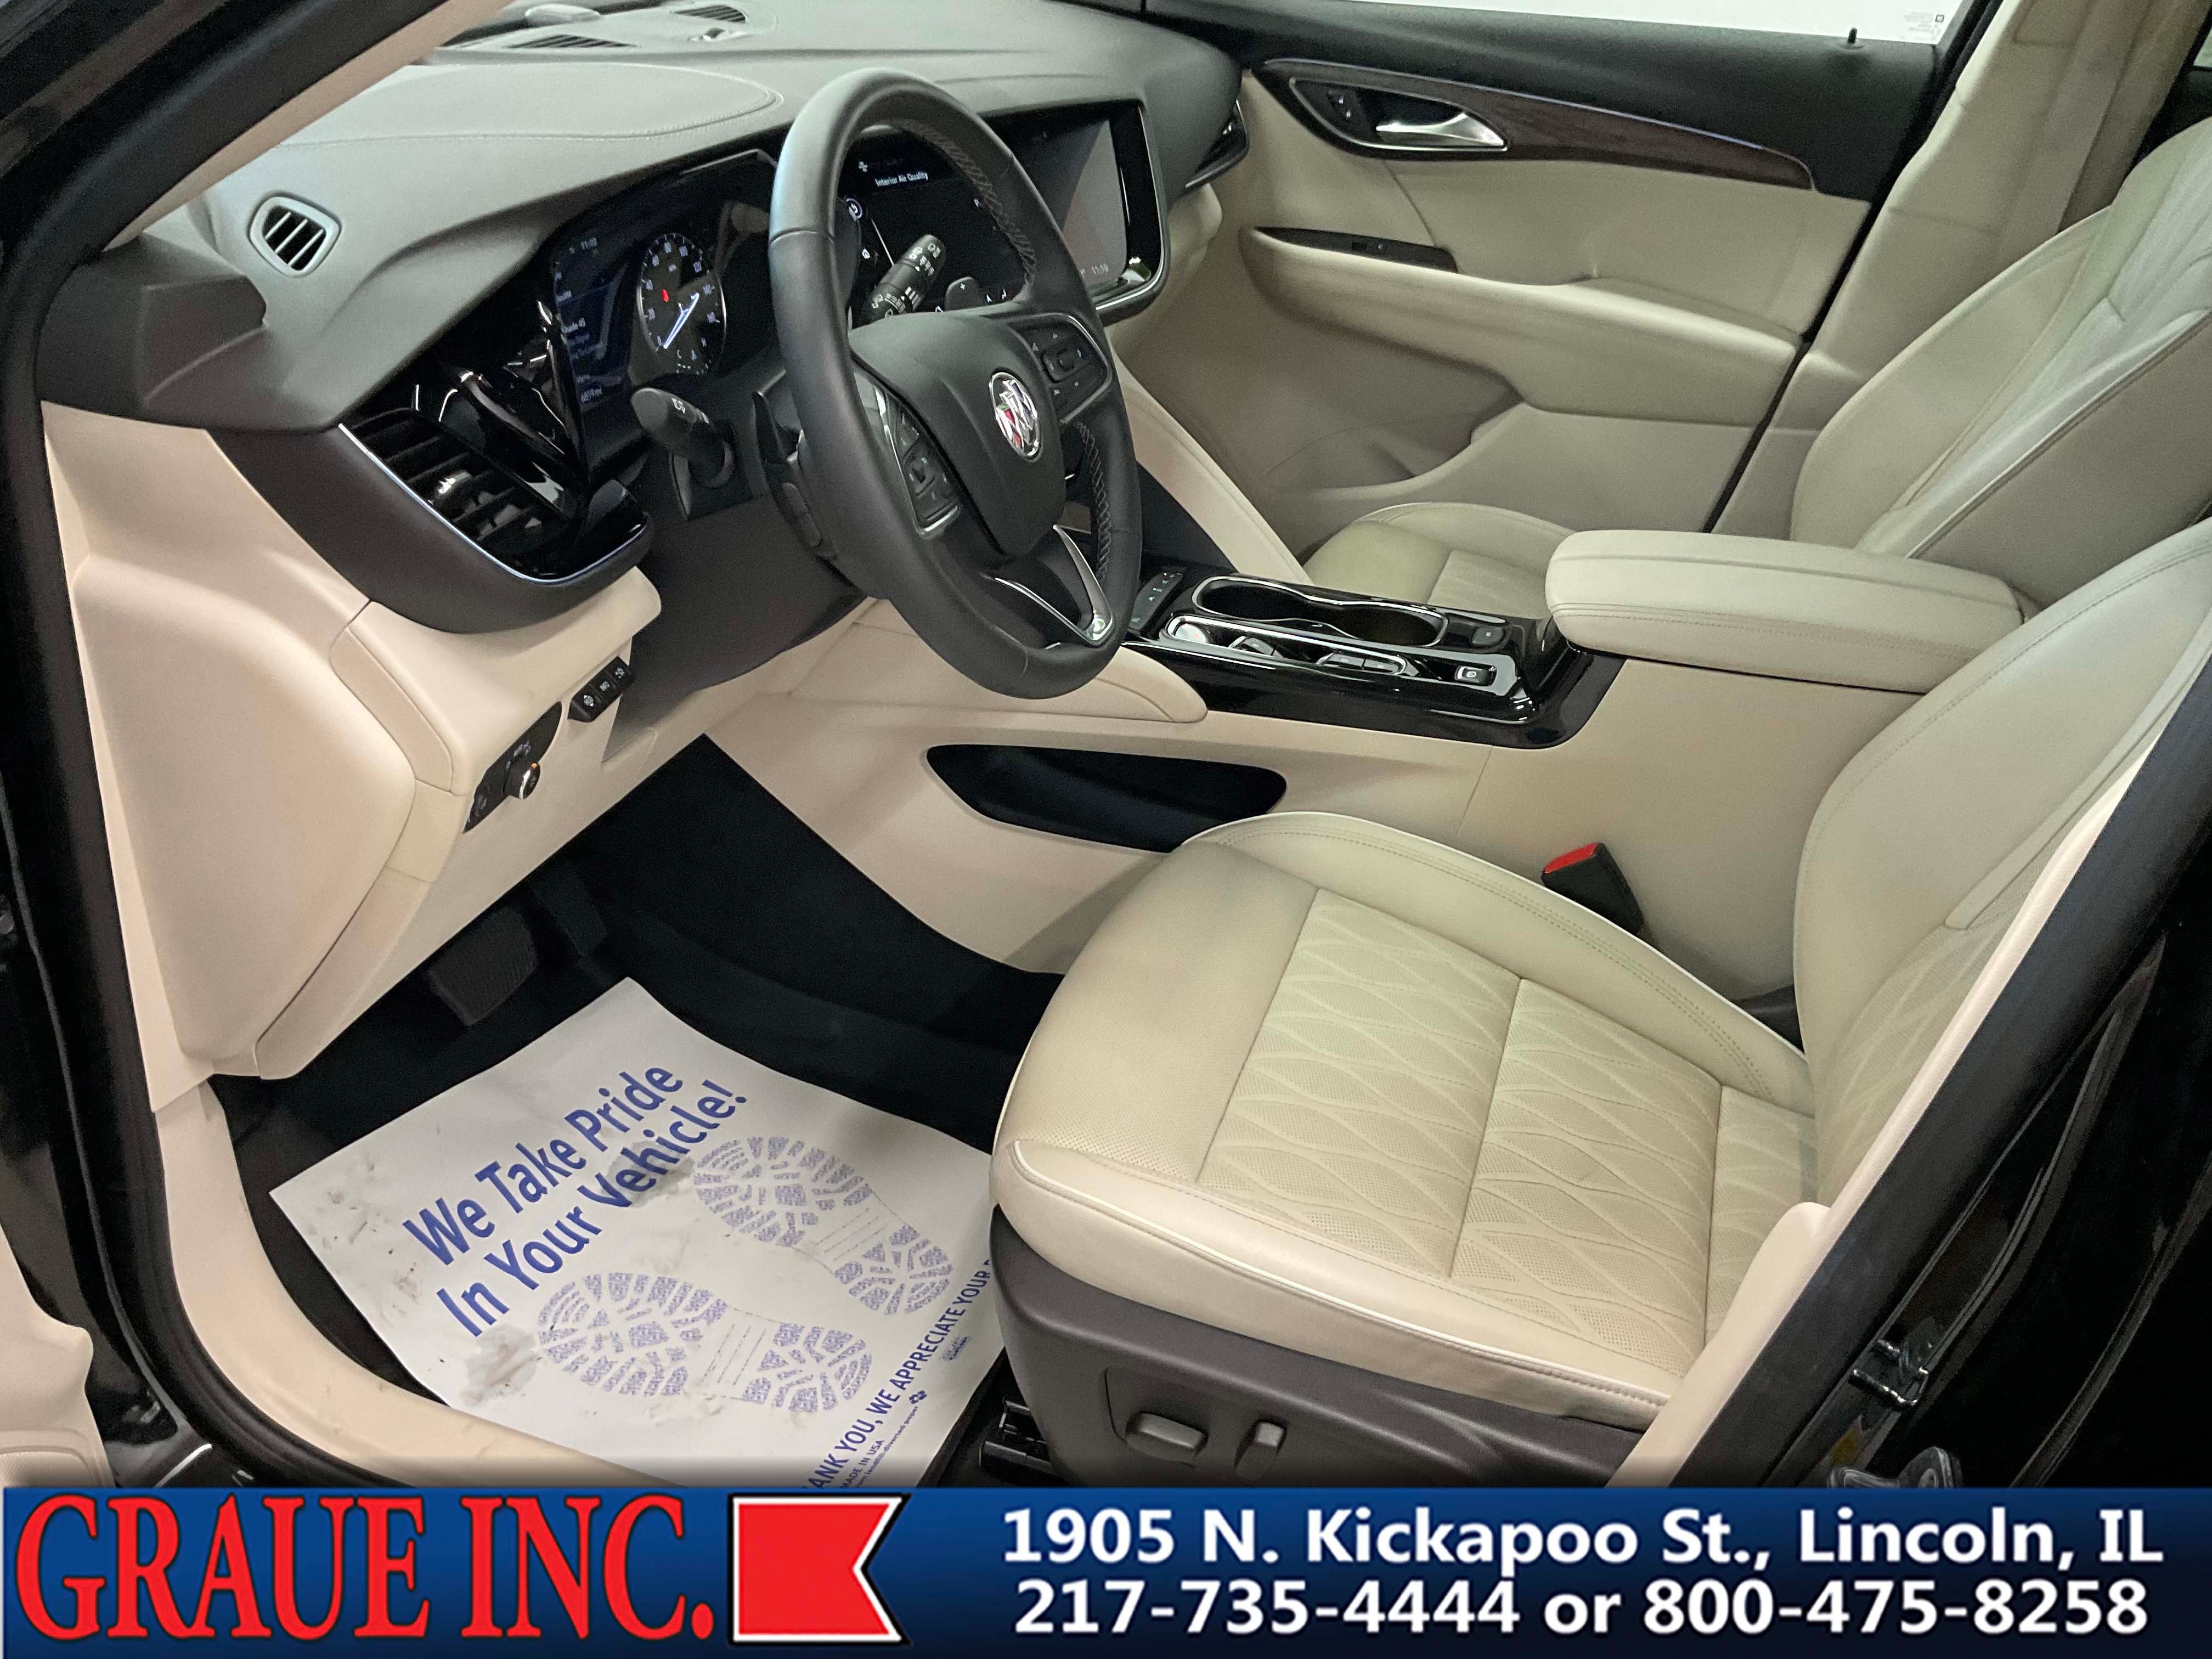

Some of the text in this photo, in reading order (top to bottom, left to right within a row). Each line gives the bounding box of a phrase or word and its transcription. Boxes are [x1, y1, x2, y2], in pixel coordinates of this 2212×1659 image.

[874, 171, 928, 187] Interior Air Quality
[402, 1066, 684, 1266] We Take Pride
[436, 1079, 747, 1337] In Your Vehicle!
[802, 1453, 850, 1488] ANK
[834, 1419, 883, 1452] YOU,
[865, 1389, 901, 1414] WE
[889, 1307, 966, 1391] APPRECIATE
[952, 1271, 991, 1305] YOUR
[904, 1406, 918, 1424] paper
[859, 1457, 870, 1466] IN
[867, 1440, 885, 1455] USA
